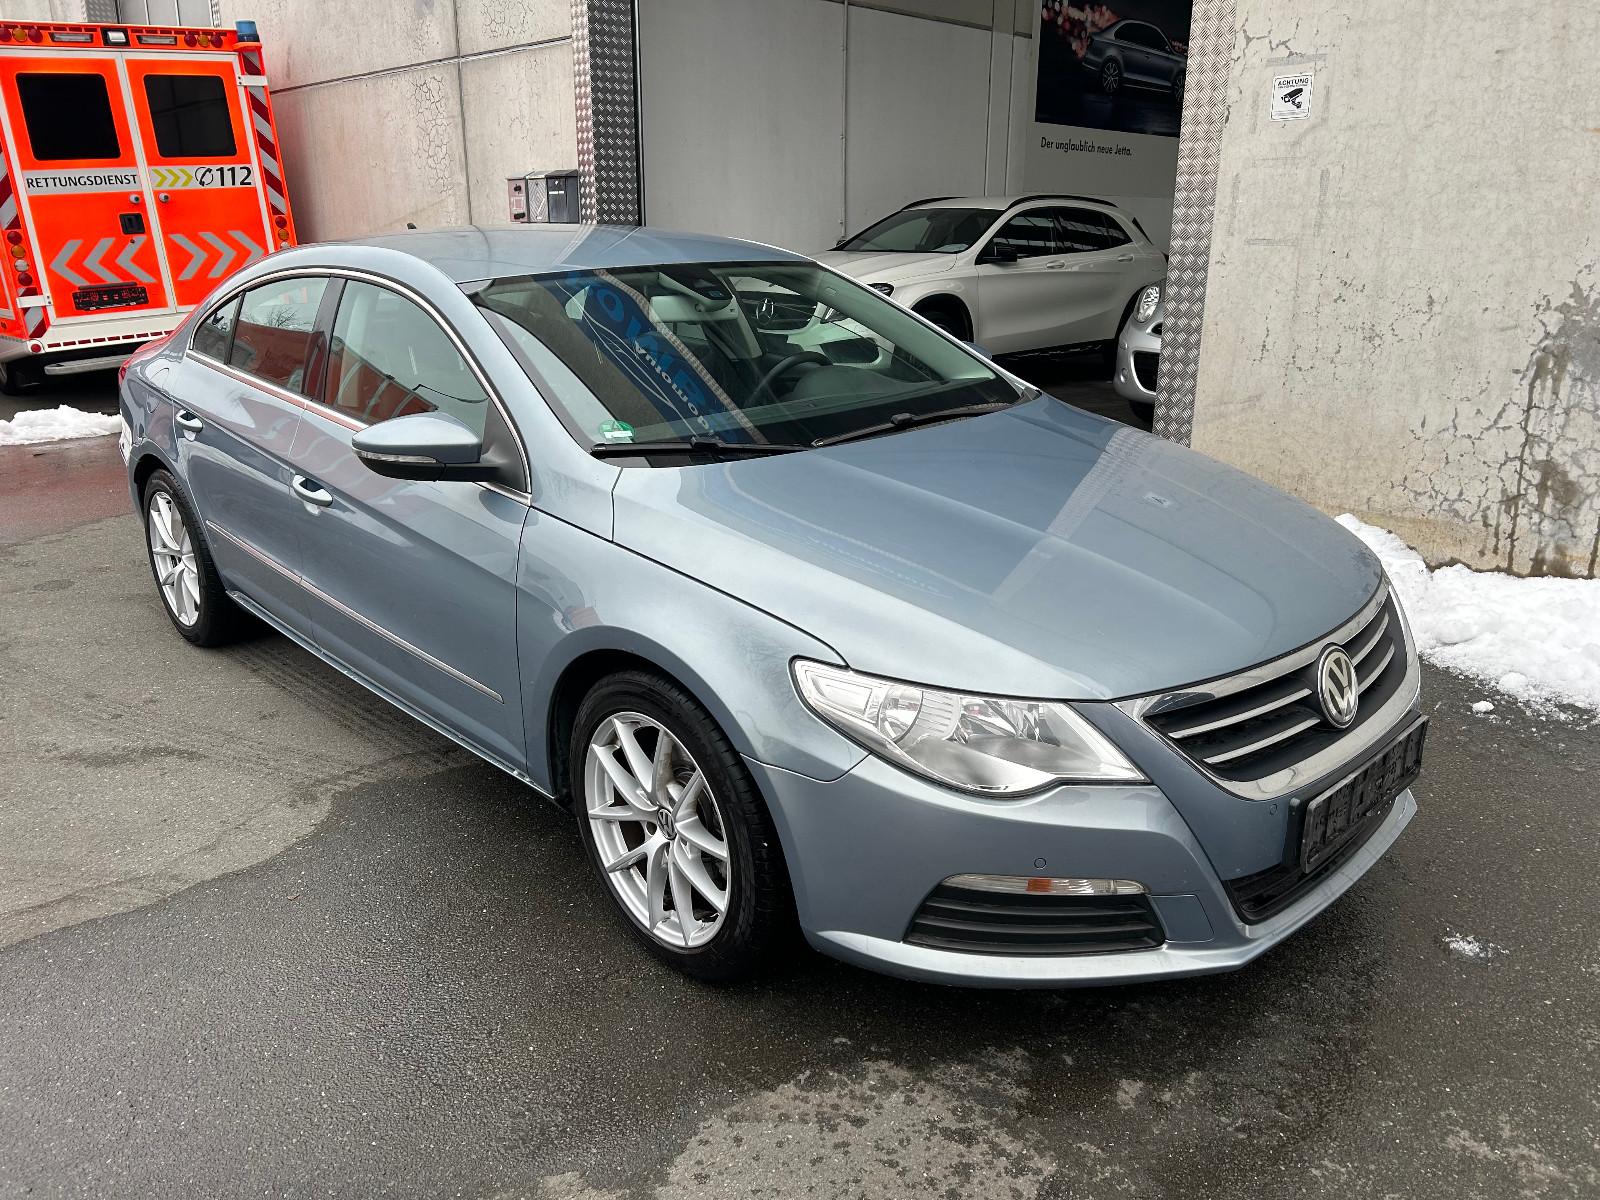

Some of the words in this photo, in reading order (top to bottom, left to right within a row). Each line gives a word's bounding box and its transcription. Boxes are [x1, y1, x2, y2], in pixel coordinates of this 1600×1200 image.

[1278, 77, 1309, 86] ACHTUNG
[1041, 136, 1054, 149] Der
[1056, 139, 1096, 153] unglaublich
[1097, 145, 1113, 154] neue
[1114, 144, 1132, 156] Jetta.
[26, 174, 137, 188] RETTUNGSDIENST
[215, 166, 252, 186] 112
